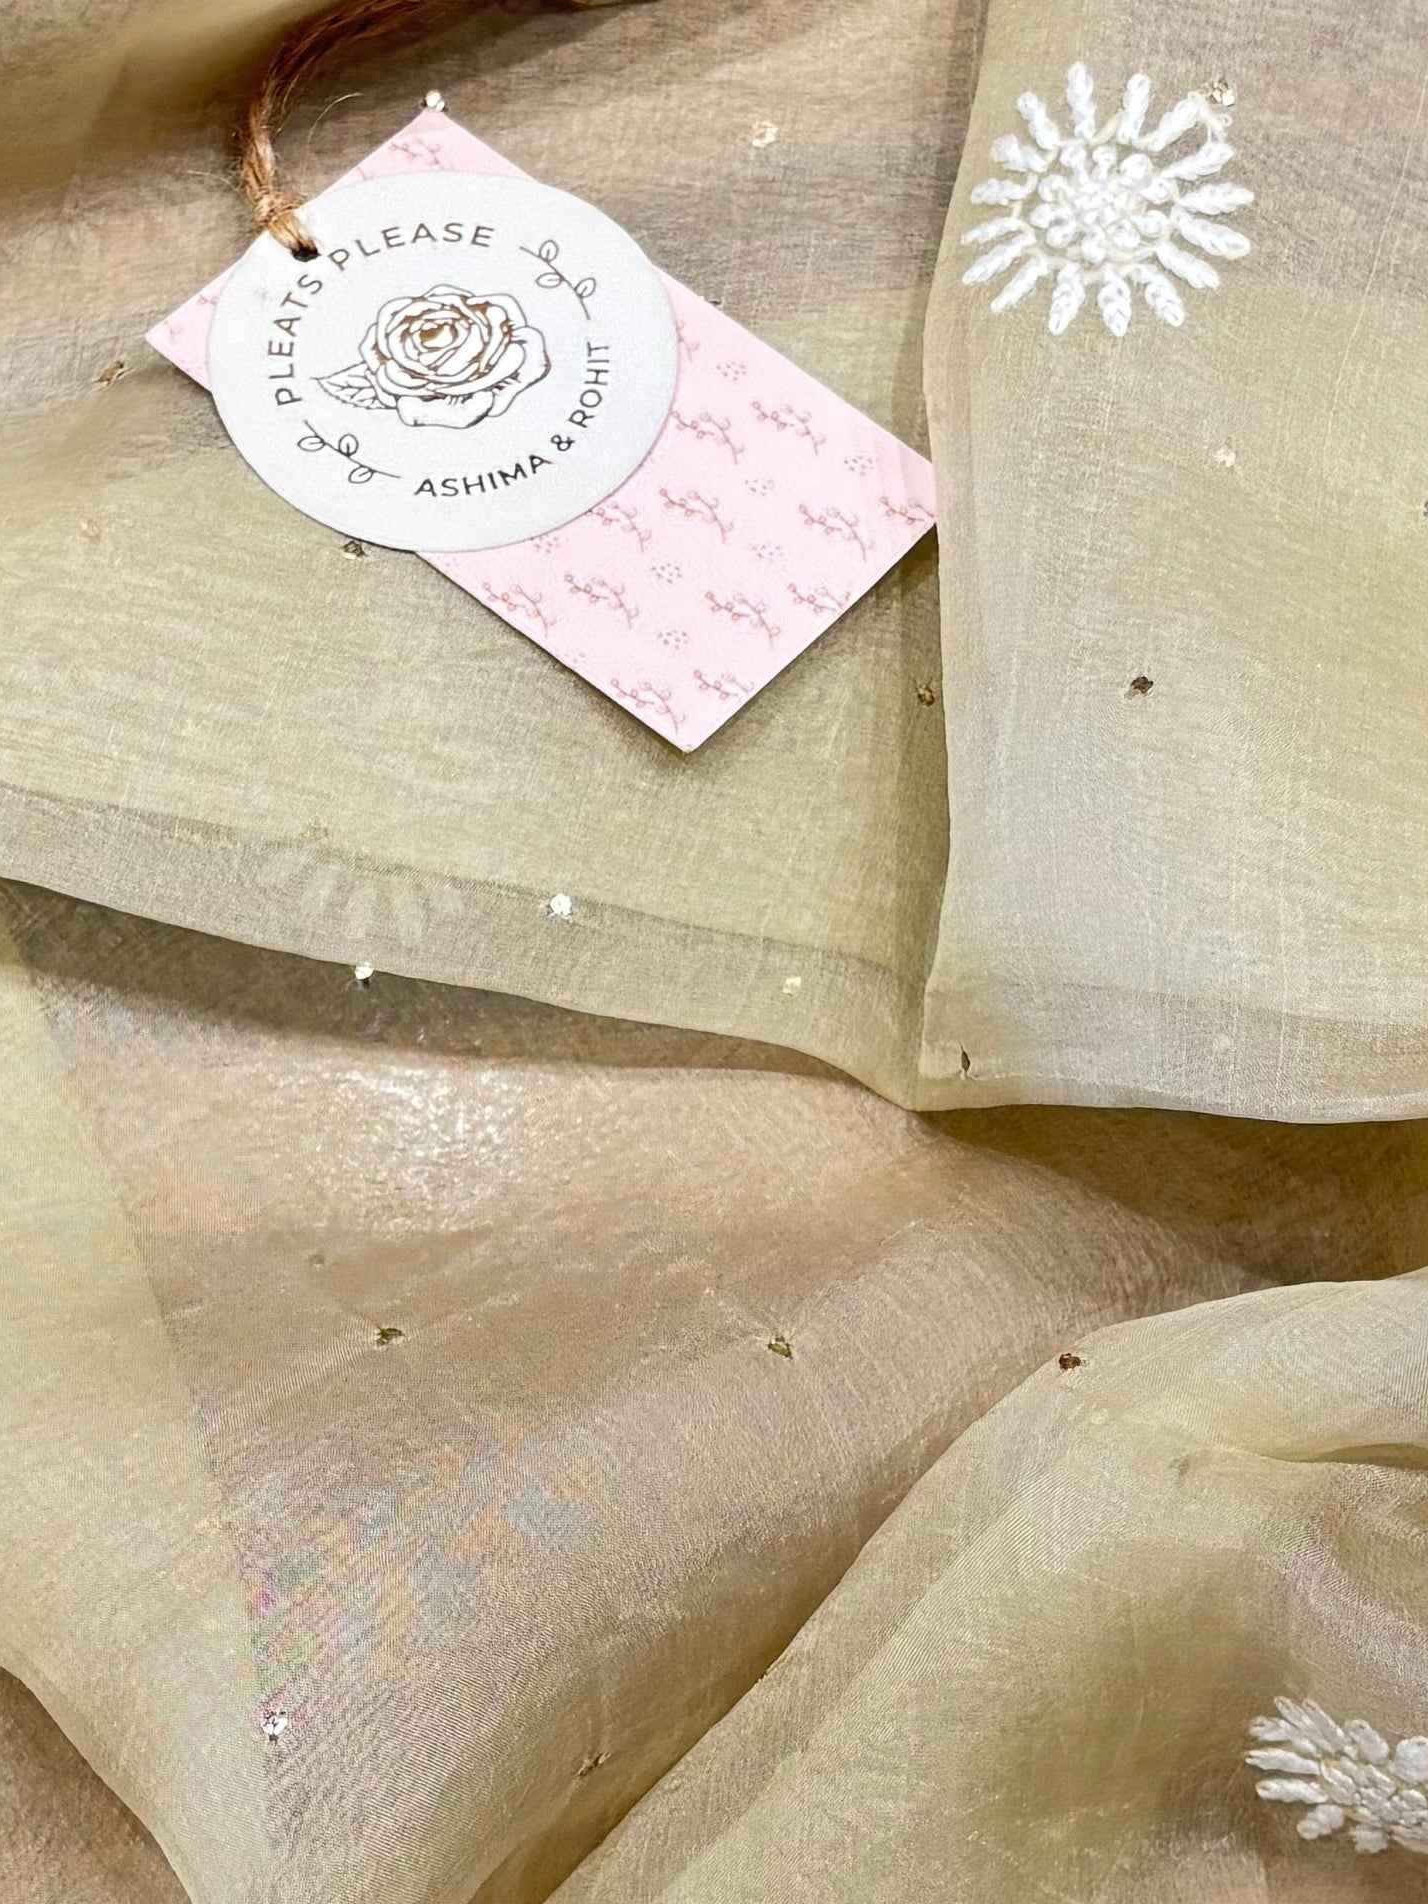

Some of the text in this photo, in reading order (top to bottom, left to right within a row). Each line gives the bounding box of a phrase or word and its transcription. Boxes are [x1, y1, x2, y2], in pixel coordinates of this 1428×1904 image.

[269, 222, 495, 406] PLEATS PLEASE
[414, 341, 610, 498] ASHIMA & ROHIT
